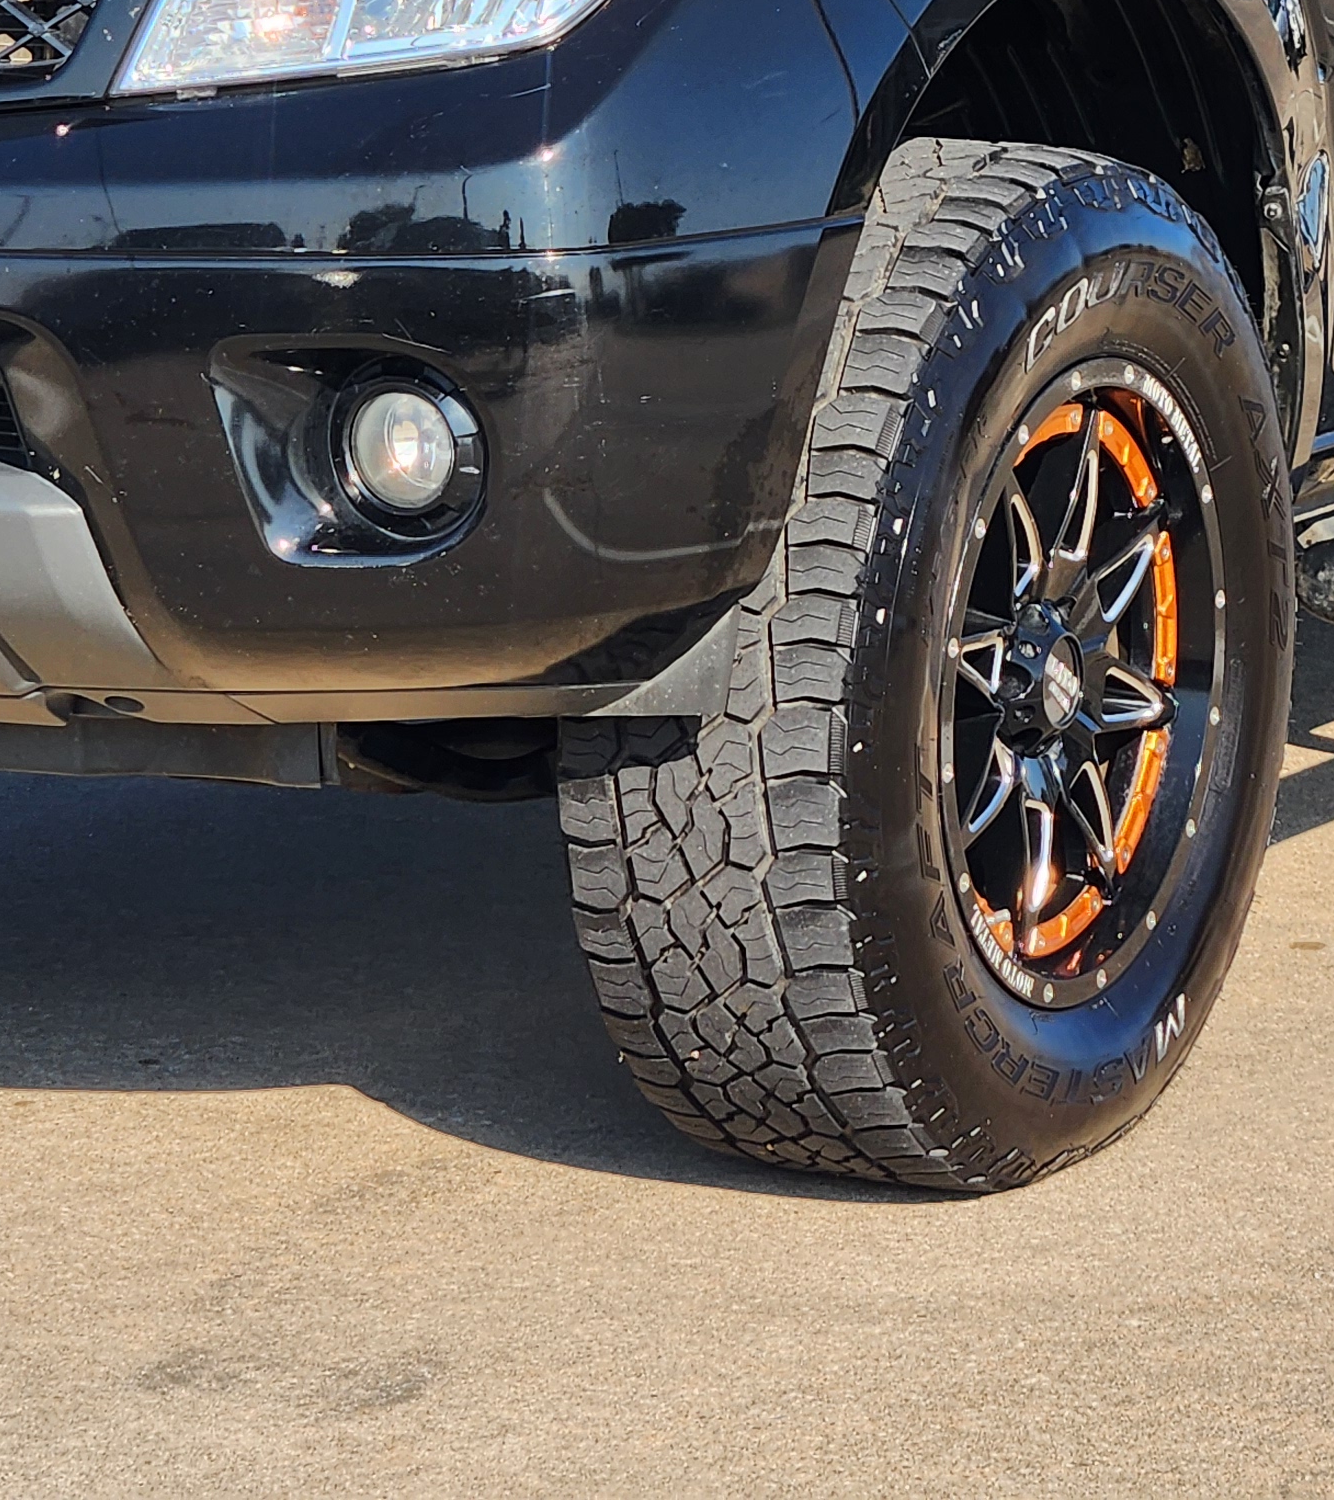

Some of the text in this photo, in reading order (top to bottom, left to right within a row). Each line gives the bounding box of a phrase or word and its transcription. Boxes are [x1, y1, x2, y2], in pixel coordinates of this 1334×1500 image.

[1024, 258, 1237, 374] COURSER
[1142, 373, 1175, 415] MOTO
[914, 741, 1186, 1105] MASTERCRAFT
[1001, 958, 1035, 998] MOTO
